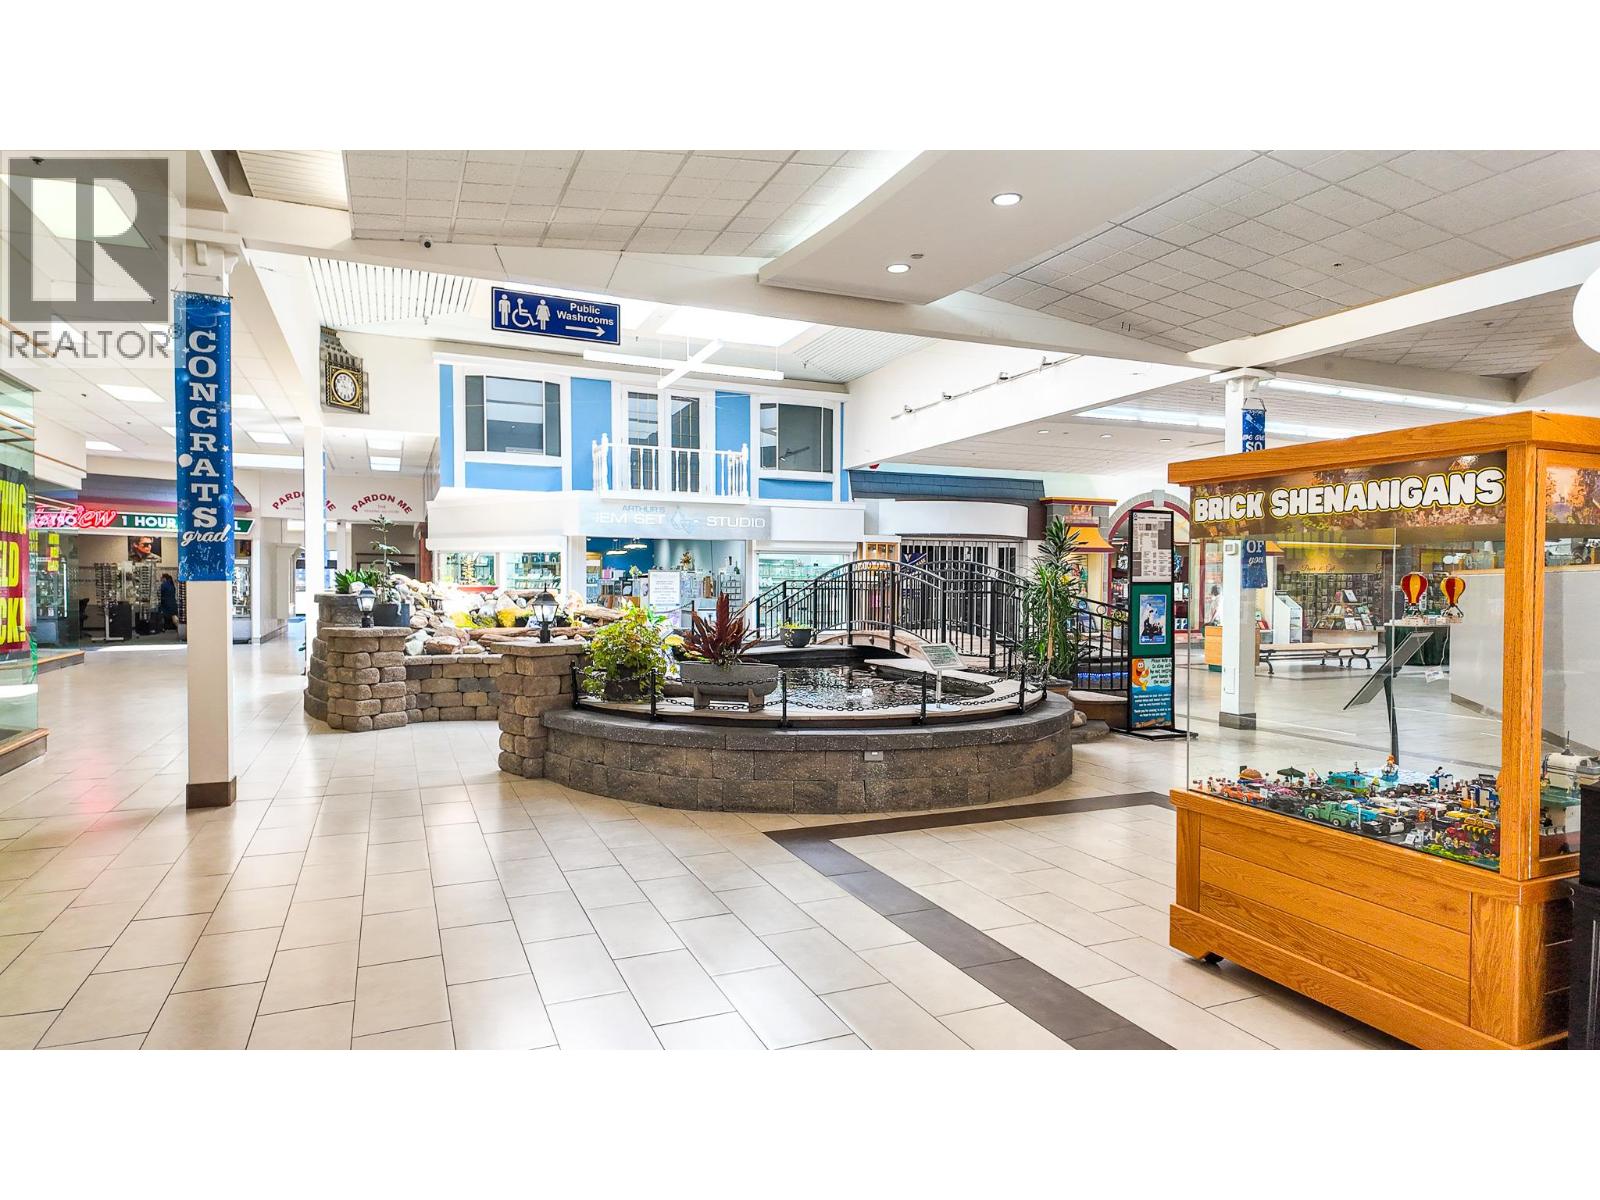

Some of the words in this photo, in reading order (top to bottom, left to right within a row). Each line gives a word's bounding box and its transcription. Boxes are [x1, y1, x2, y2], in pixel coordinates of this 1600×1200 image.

[570, 302, 601, 315] Public
[556, 310, 614, 326] Washrooms
[188, 329, 220, 528] CONGRATS
[271, 490, 305, 510] PARD
[1194, 492, 1266, 523] BRICK
[1269, 468, 1506, 518] SHENANIGANS
[351, 493, 396, 512] PARDON
[397, 499, 413, 515] ME
[121, 515, 128, 526] 1
[134, 516, 177, 530] HOUR
[633, 513, 666, 525] SET
[705, 516, 766, 529] STUDIO
[180, 523, 232, 547] grad
[1246, 540, 1265, 553] OF
[1248, 557, 1264, 566] you
